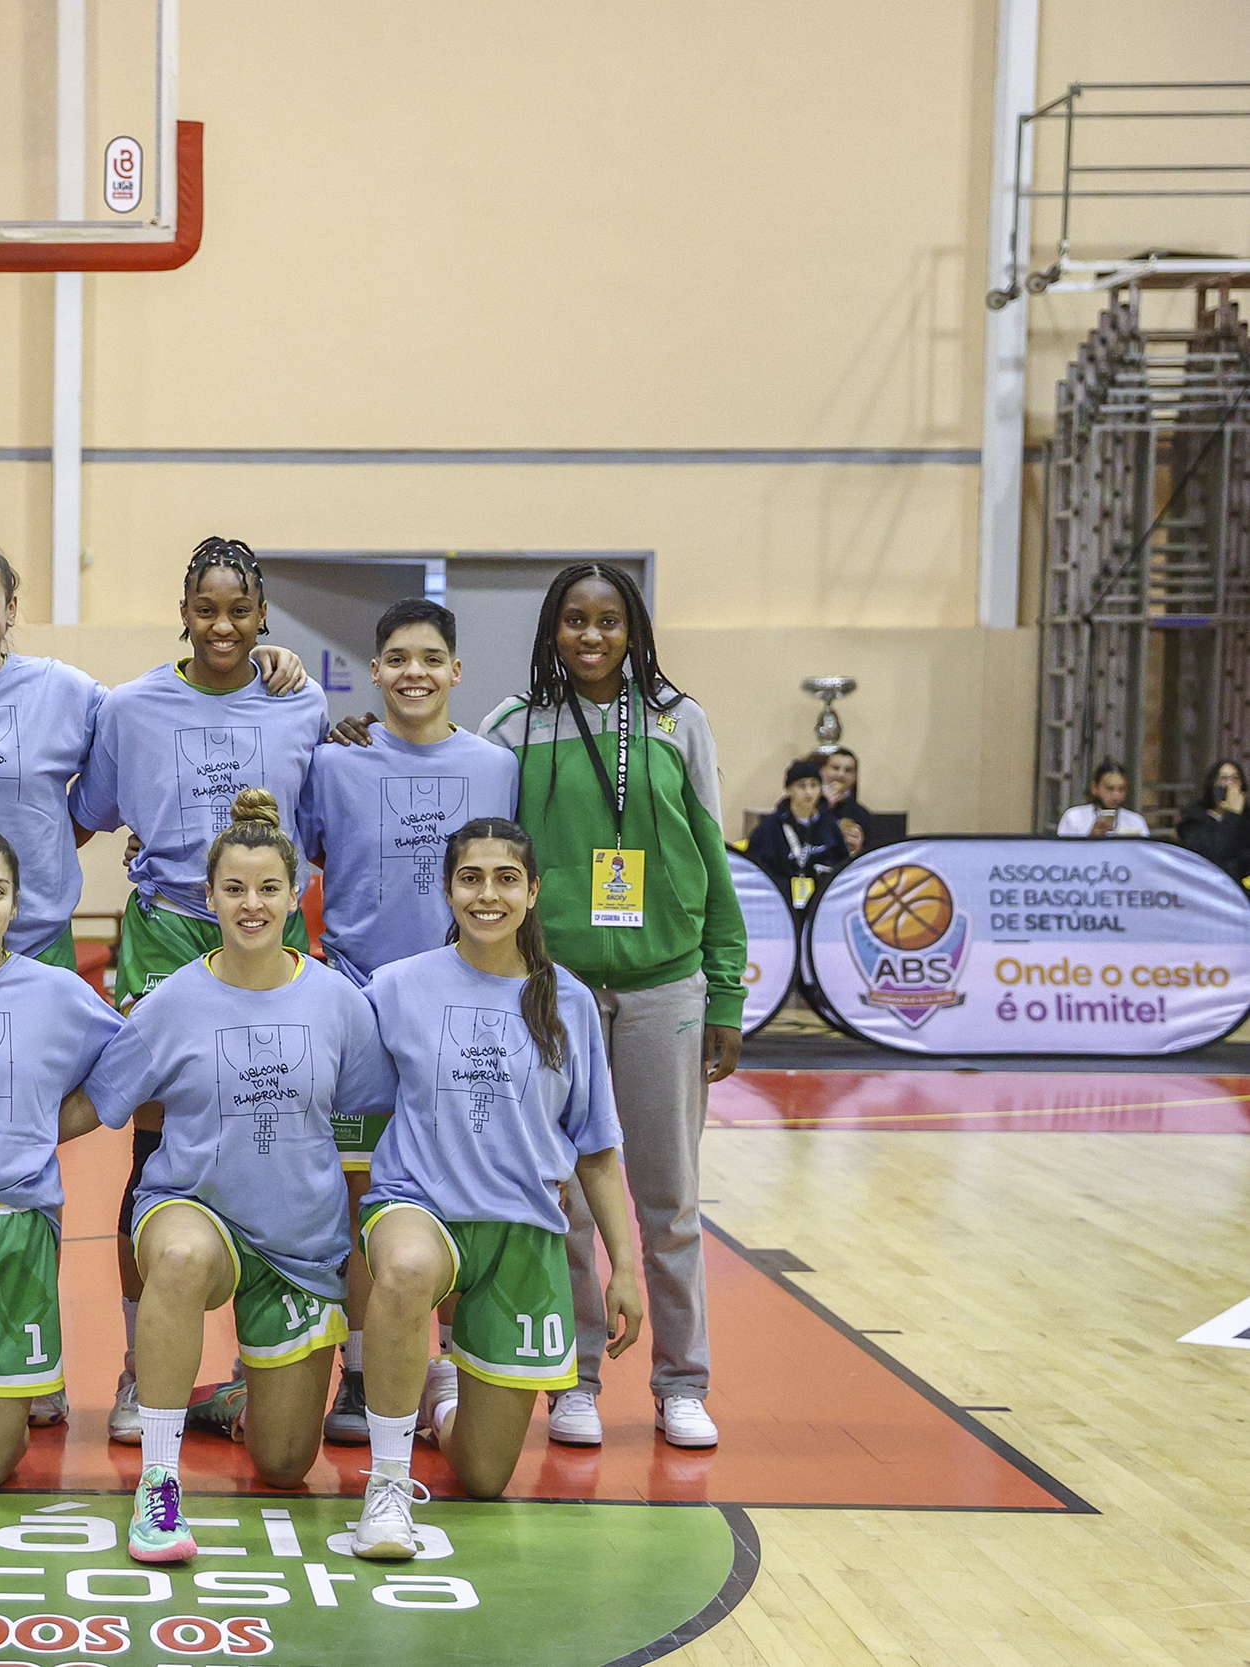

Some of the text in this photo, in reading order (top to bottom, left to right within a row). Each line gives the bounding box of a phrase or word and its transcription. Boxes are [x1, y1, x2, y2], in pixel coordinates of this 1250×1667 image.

[207, 772, 232, 784] TO MY
[411, 823, 437, 834] TO MY
[394, 833, 449, 849] PLAYGROUN
[989, 861, 1132, 887] ASSOCIAÇÃO
[990, 889, 1186, 909] DE BASQUETEBOL
[991, 909, 1126, 932] DE SETÚBAL
[875, 958, 952, 983] ABS
[996, 957, 1230, 988] Onde o cesto
[997, 992, 1166, 1023] é o limite!
[471, 1059, 498, 1070] TO MY
[251, 1076, 279, 1089] TO MY
[24, 1323, 49, 1365] 1
[515, 1313, 565, 1358] 10
[149, 1615, 275, 1656] OS
